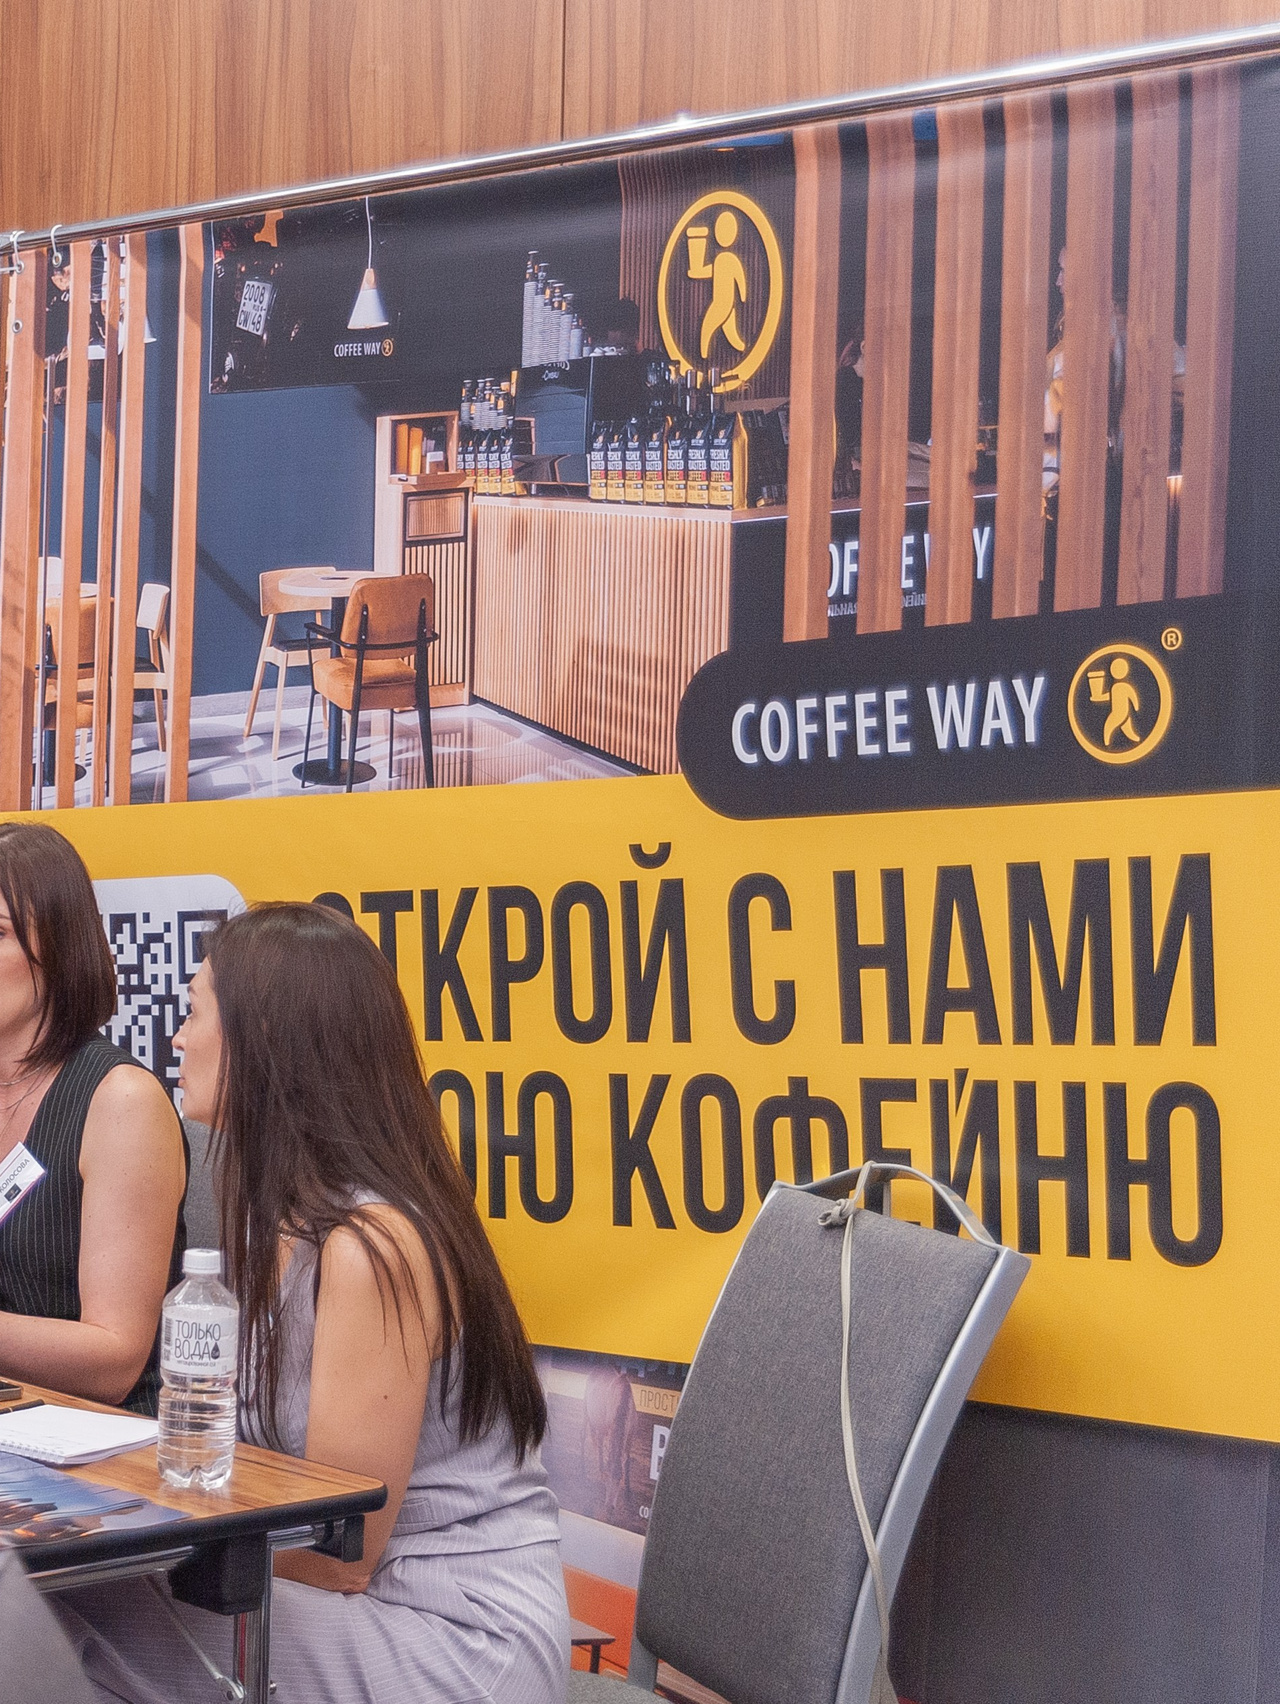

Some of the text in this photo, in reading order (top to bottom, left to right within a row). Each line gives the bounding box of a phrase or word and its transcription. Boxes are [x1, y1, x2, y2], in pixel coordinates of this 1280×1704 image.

[244, 284, 266, 304] 2008
[252, 312, 262, 332] 48
[334, 341, 382, 358] COFFEE WAY
[730, 676, 1046, 765] COFFEE WAY
[726, 872, 797, 1046] С
[832, 852, 1218, 1047] НАМИ
[0, 1158, 30, 1194] КОЛОСОВА
[608, 1067, 1224, 1269] КОФЕЙНЮ
[175, 1319, 221, 1343] ТОЛЬКО
[174, 1338, 212, 1361] ВОДА
[640, 1389, 681, 1412] ПРОСТ
